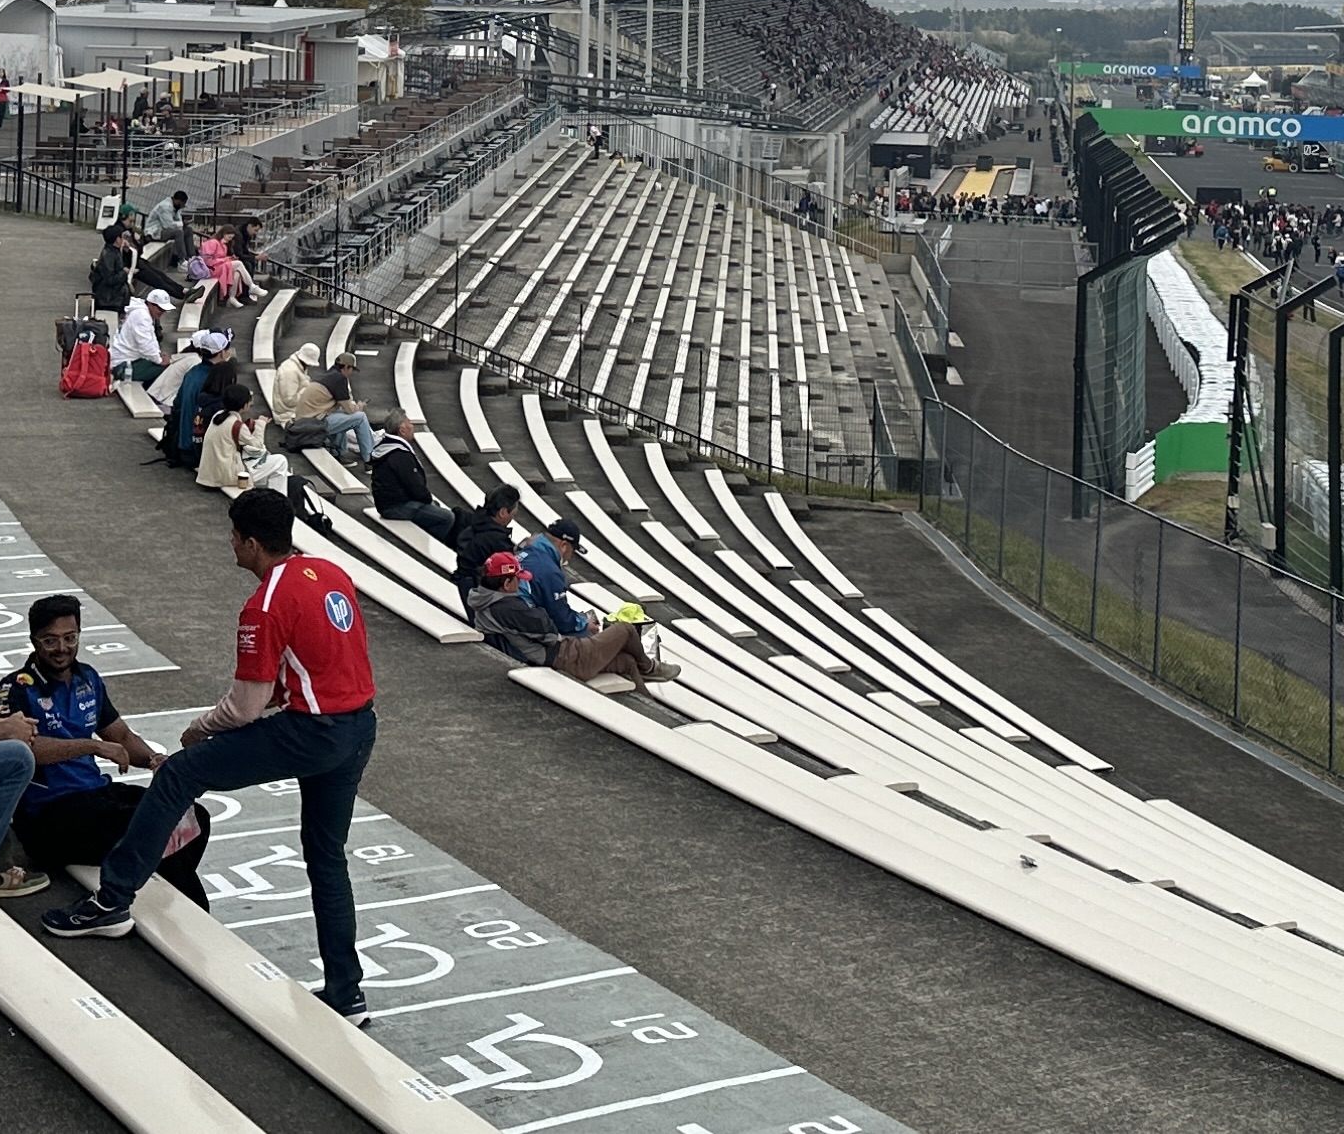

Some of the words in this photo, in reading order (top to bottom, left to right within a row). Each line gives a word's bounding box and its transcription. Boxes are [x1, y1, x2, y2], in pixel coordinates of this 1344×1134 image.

[1103, 64, 1157, 76] aramco
[1182, 114, 1302, 138] aramco
[11, 568, 50, 579] 14
[326, 594, 348, 630] hp
[85, 641, 131, 656] 16
[353, 844, 414, 865] 19
[463, 919, 549, 950] 20
[610, 1012, 699, 1044] 21
